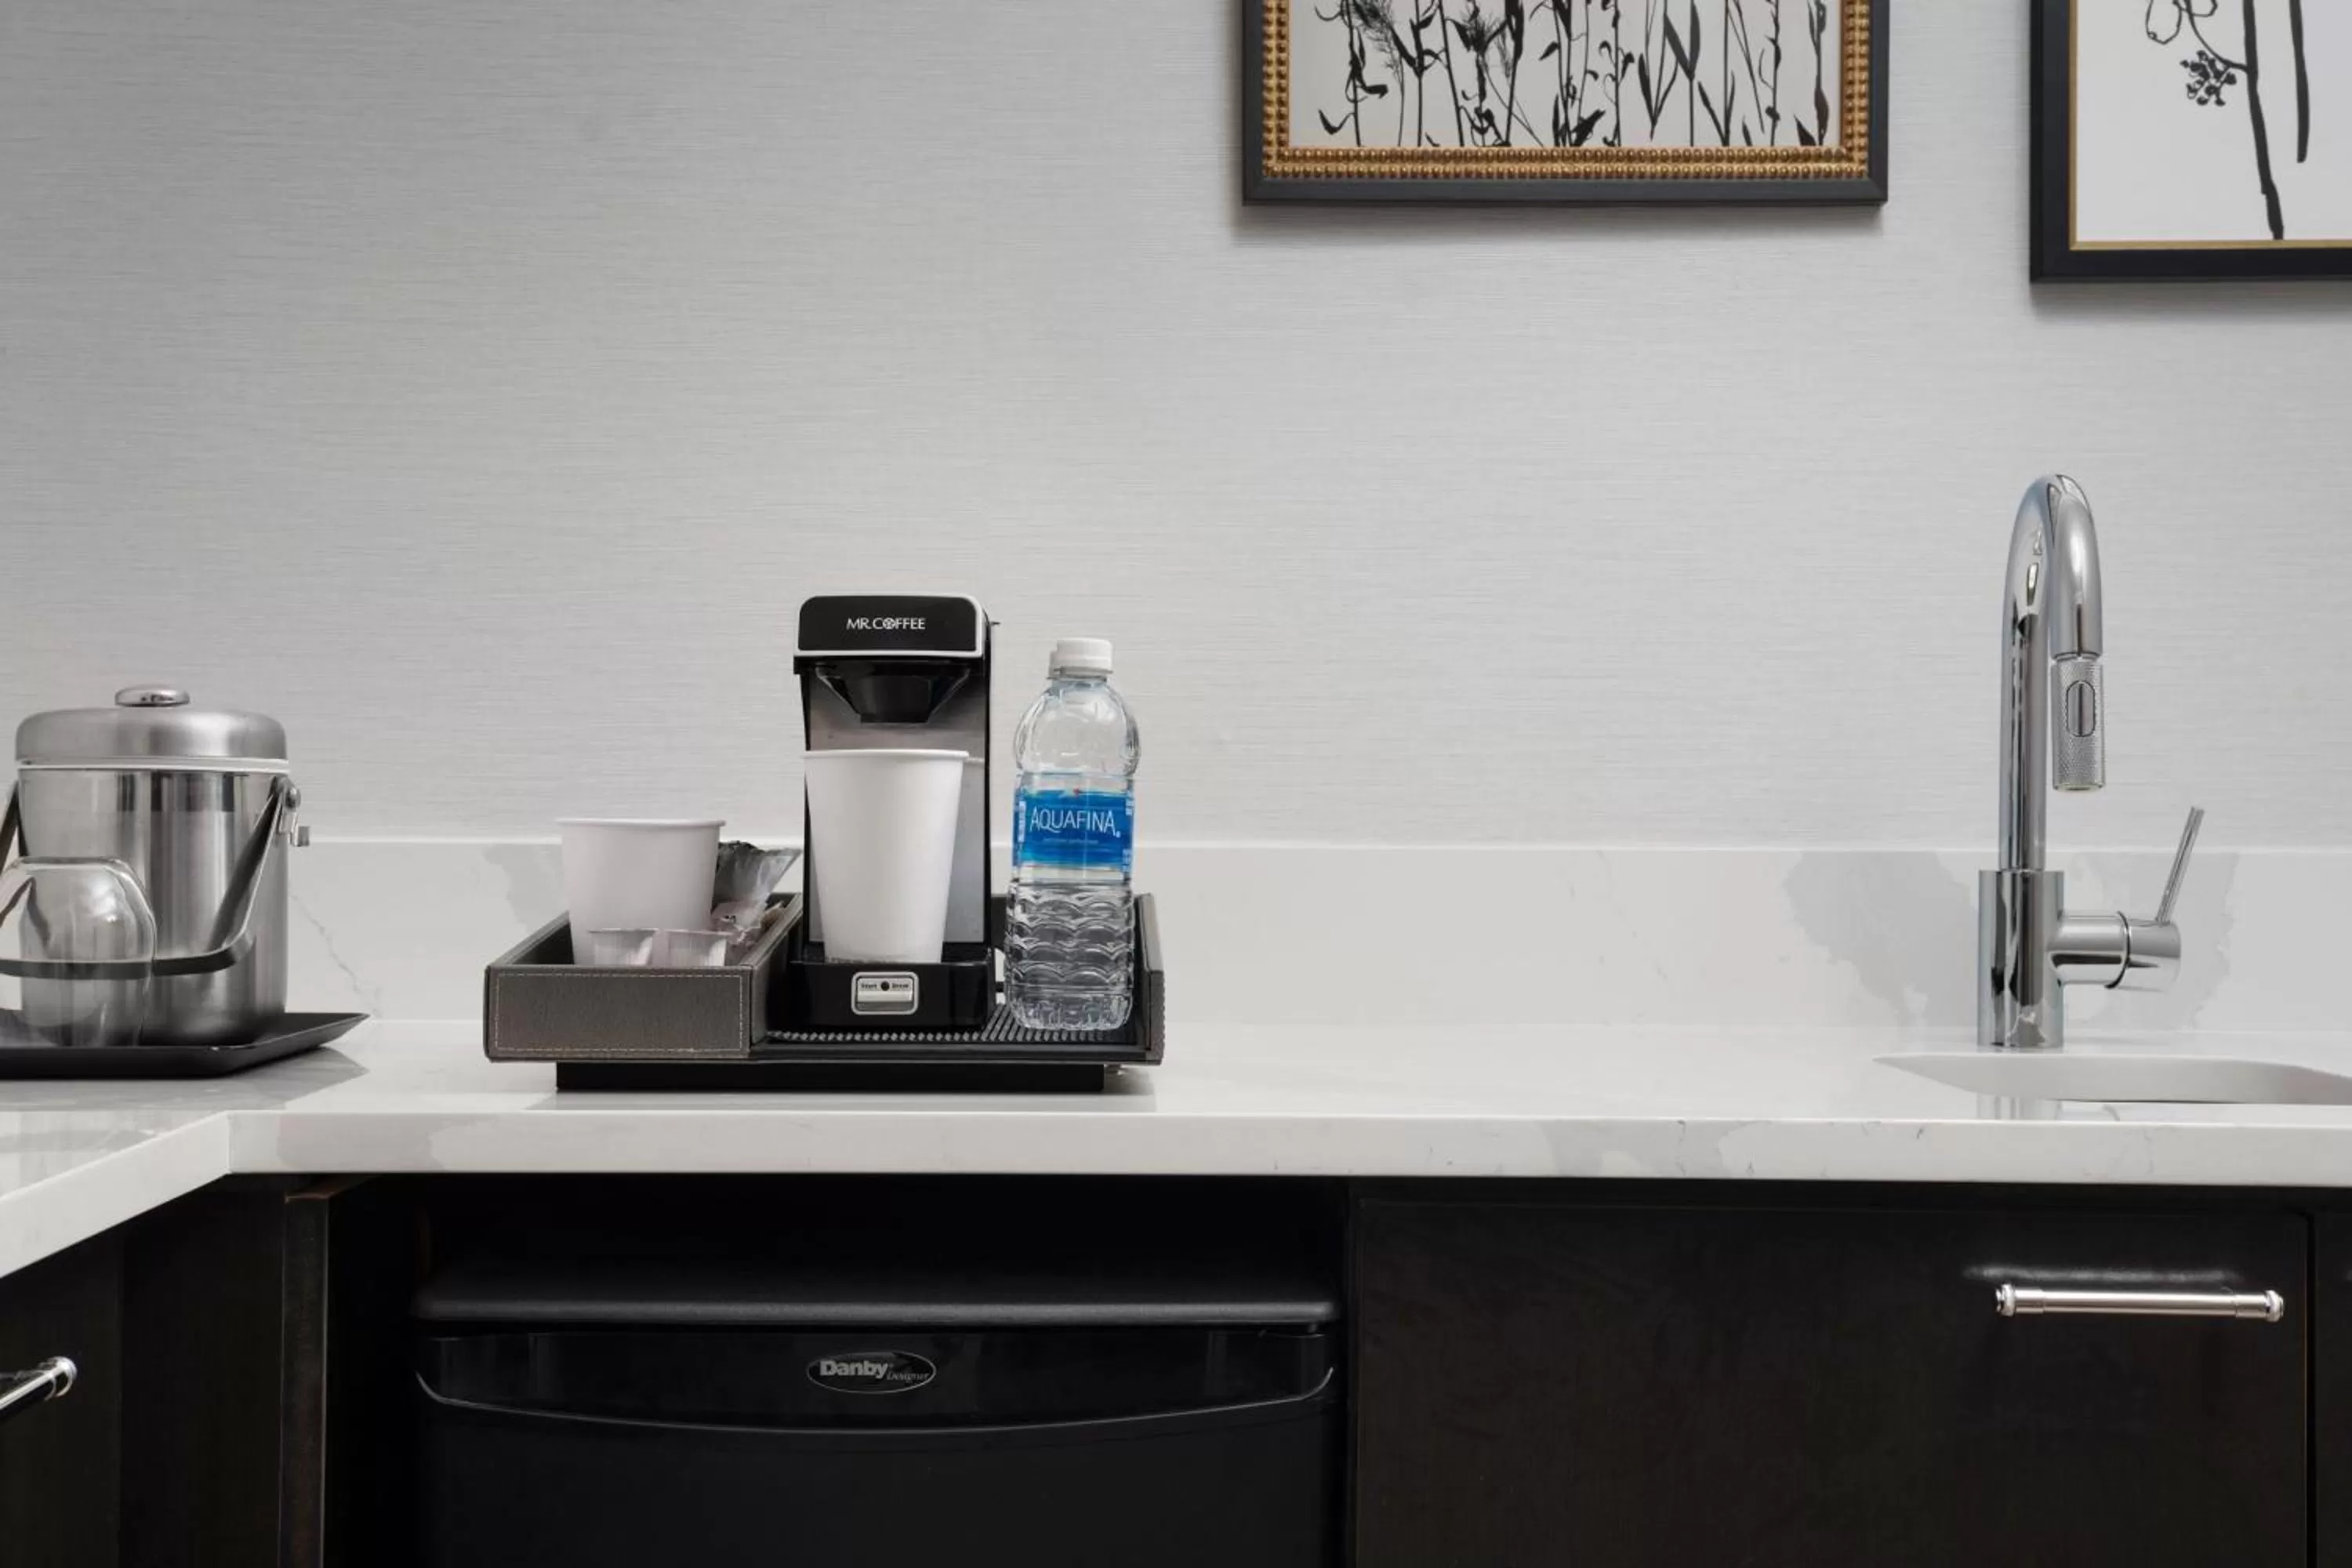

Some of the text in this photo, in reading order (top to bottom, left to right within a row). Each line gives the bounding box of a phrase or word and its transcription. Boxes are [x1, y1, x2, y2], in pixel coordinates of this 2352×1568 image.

[873, 617, 926, 630] COFFEE
[1029, 805, 1117, 837] AQUAFINA
[819, 1359, 888, 1379] Danby
